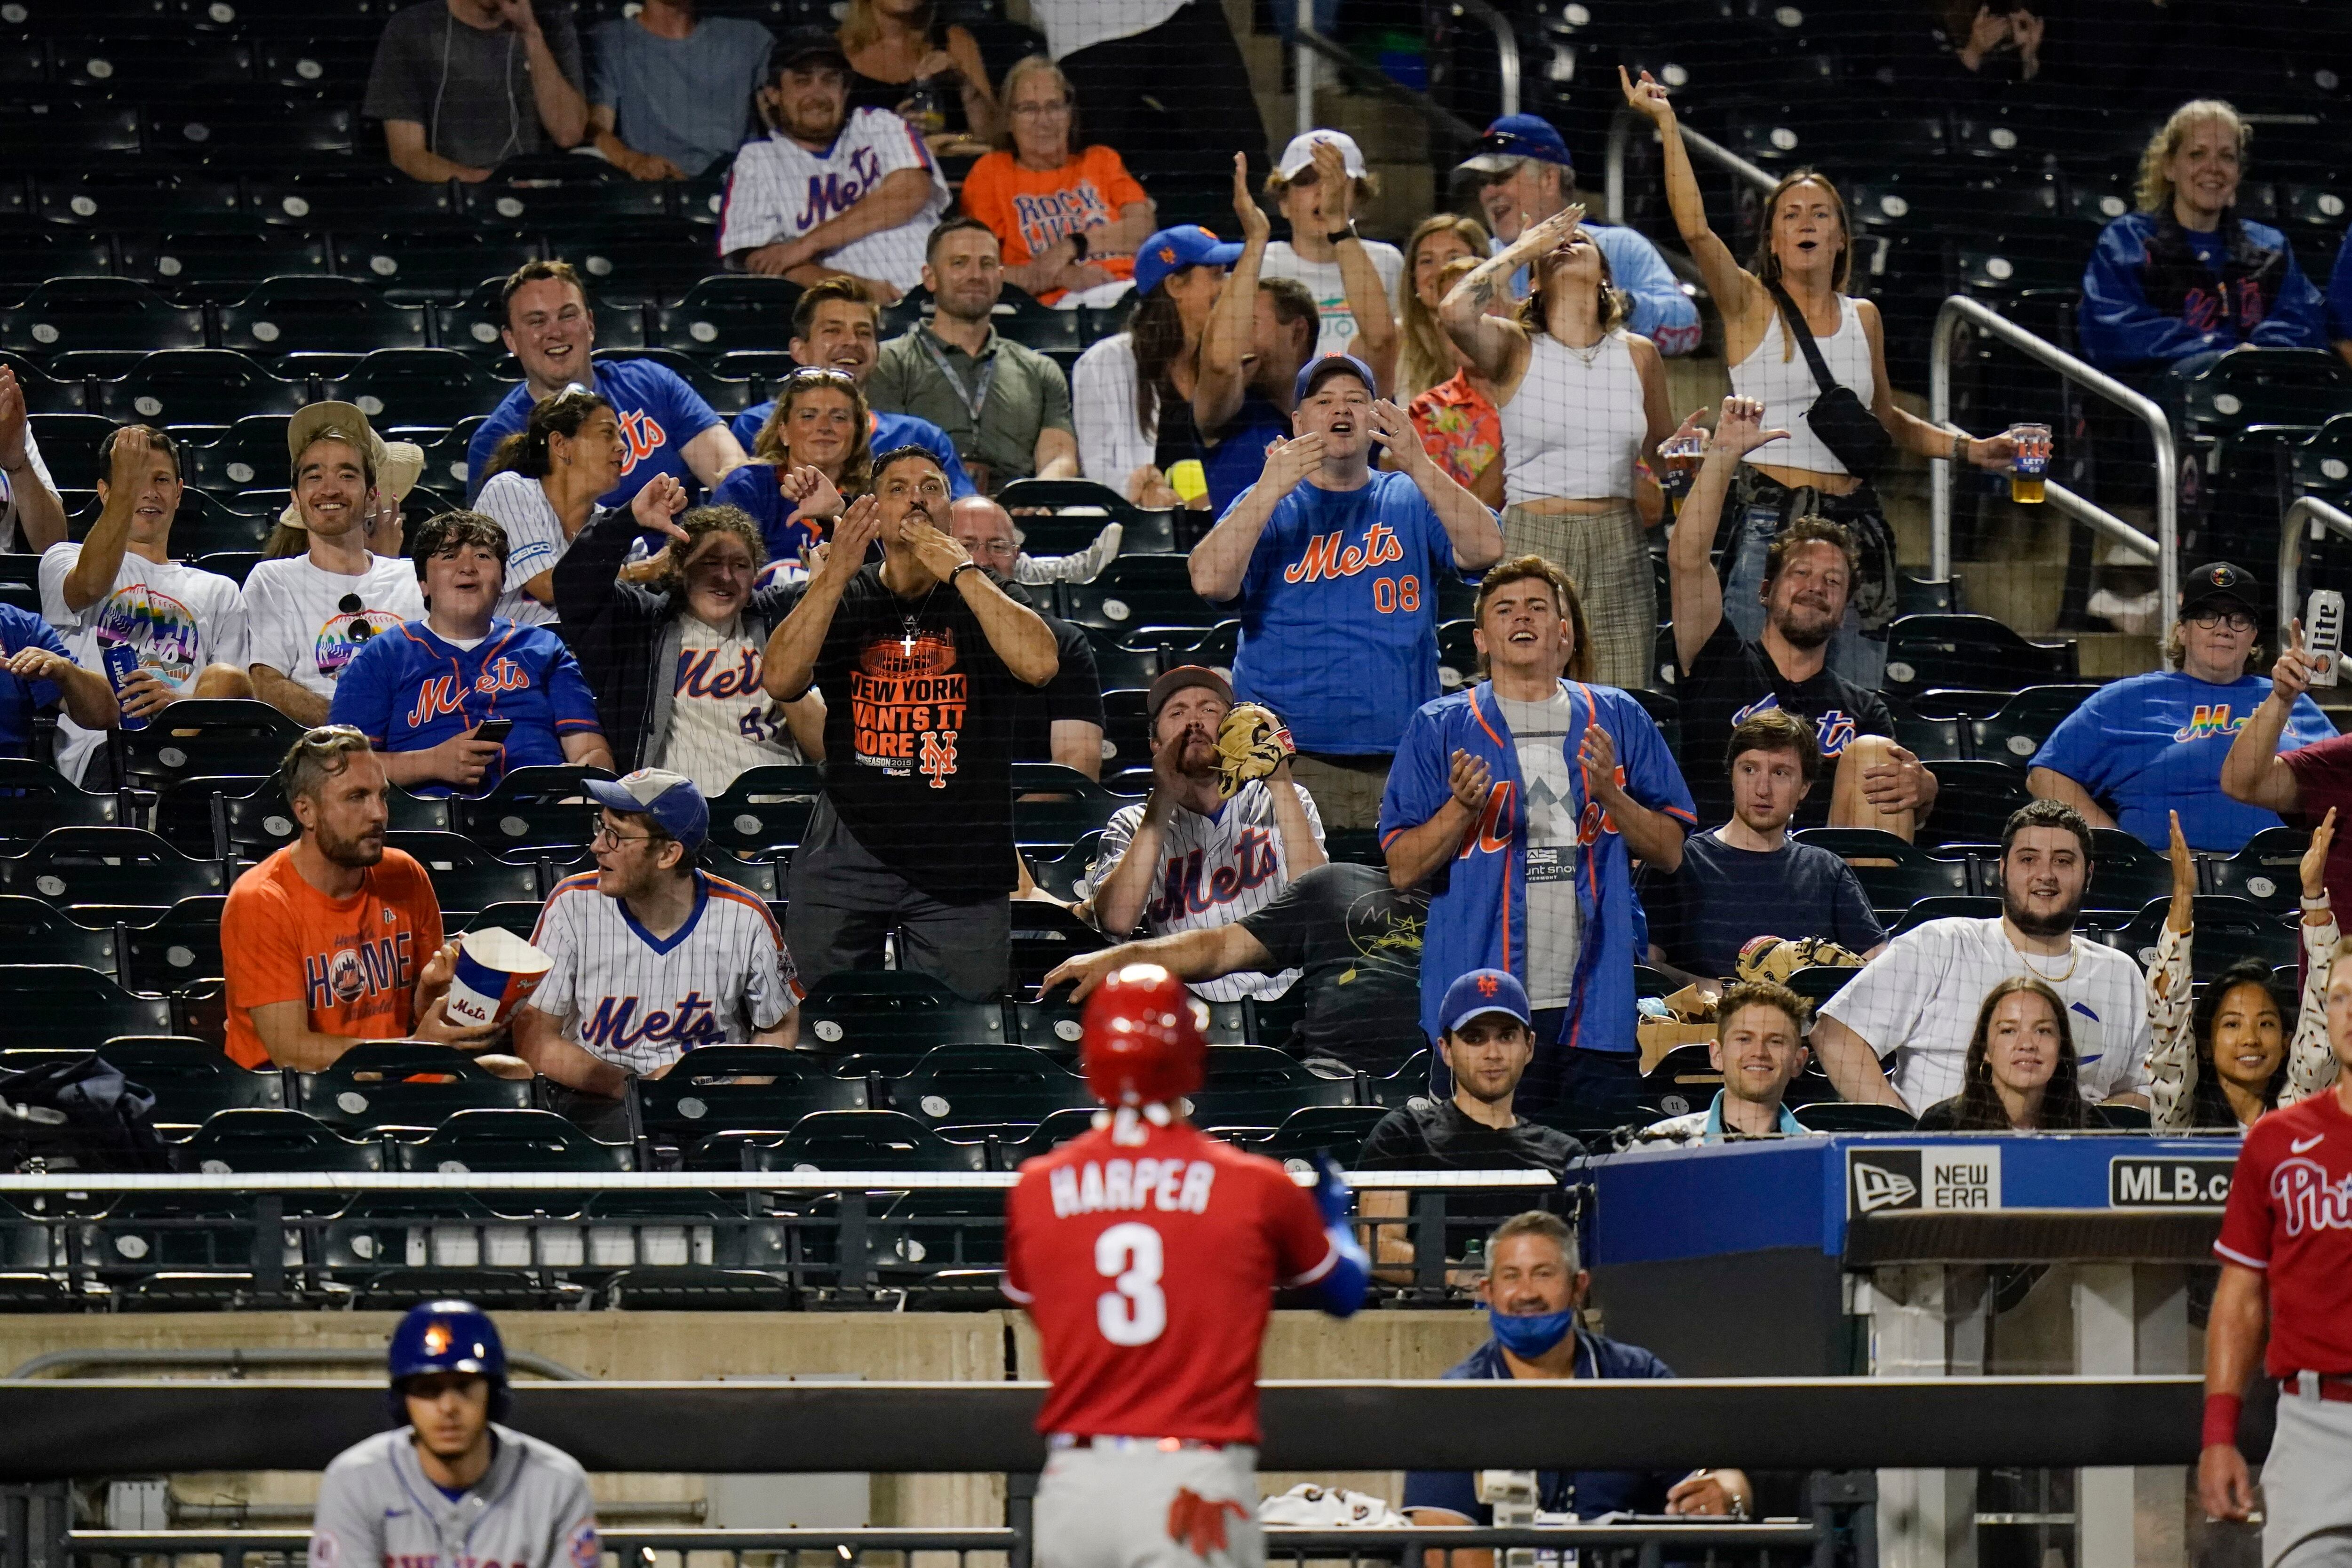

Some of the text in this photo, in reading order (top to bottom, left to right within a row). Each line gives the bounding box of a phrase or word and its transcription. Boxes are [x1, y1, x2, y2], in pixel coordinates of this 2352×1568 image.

[1014, 181, 1105, 227] ROCK
[510, 543, 551, 565] GEICO
[1283, 521, 1404, 583] Mets
[1373, 574, 1420, 613] 08
[2312, 604, 2339, 653] Lite
[407, 656, 531, 728] Mets
[903, 677, 964, 700] YORK
[937, 704, 967, 730] IT
[920, 731, 958, 789] NY
[275, 822, 280, 830] 8
[1149, 826, 1279, 925] Mets
[2257, 883, 2266, 892] 16
[307, 931, 413, 1011] HOME
[1477, 975, 1498, 997] NY
[453, 999, 486, 1020] Mets
[580, 991, 708, 1050] Mets
[826, 1027, 831, 1035] 8
[1066, 1027, 1072, 1035] 9
[1670, 1102, 1679, 1110] 11
[1049, 1158, 1216, 1219] HARPER
[1935, 1164, 1989, 1184] NEW
[2120, 1165, 2234, 1202] MLB.c
[1935, 1188, 1989, 1208] ERA
[1095, 1221, 1167, 1346] 3
